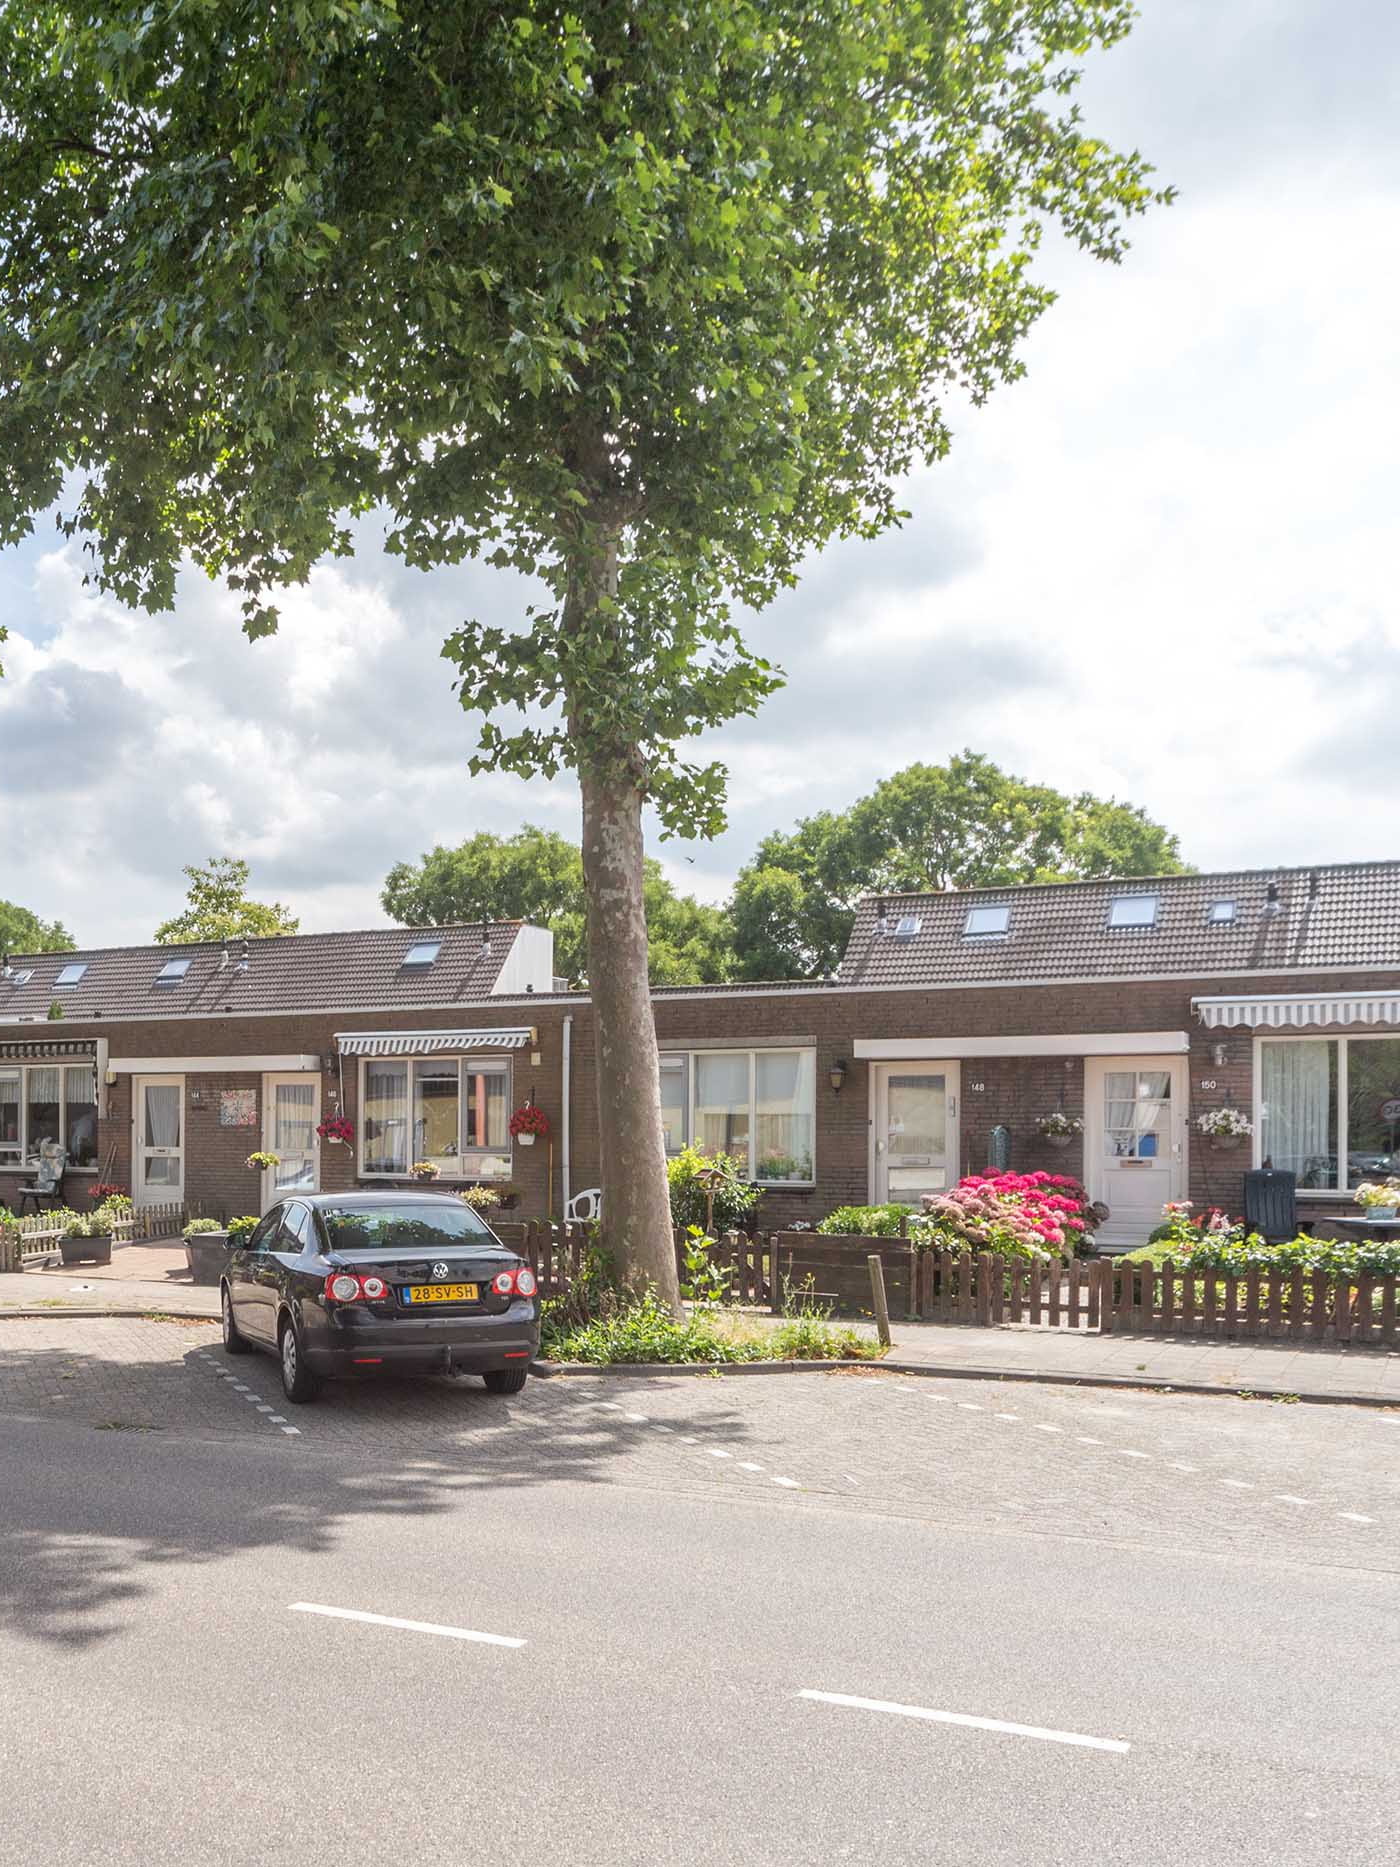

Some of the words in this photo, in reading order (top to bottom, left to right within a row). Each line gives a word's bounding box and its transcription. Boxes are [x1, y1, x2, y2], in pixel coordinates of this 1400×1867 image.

[971, 1083, 985, 1092] 148
[1201, 1080, 1216, 1089] 150
[414, 1286, 473, 1300] 28-SV-SH
